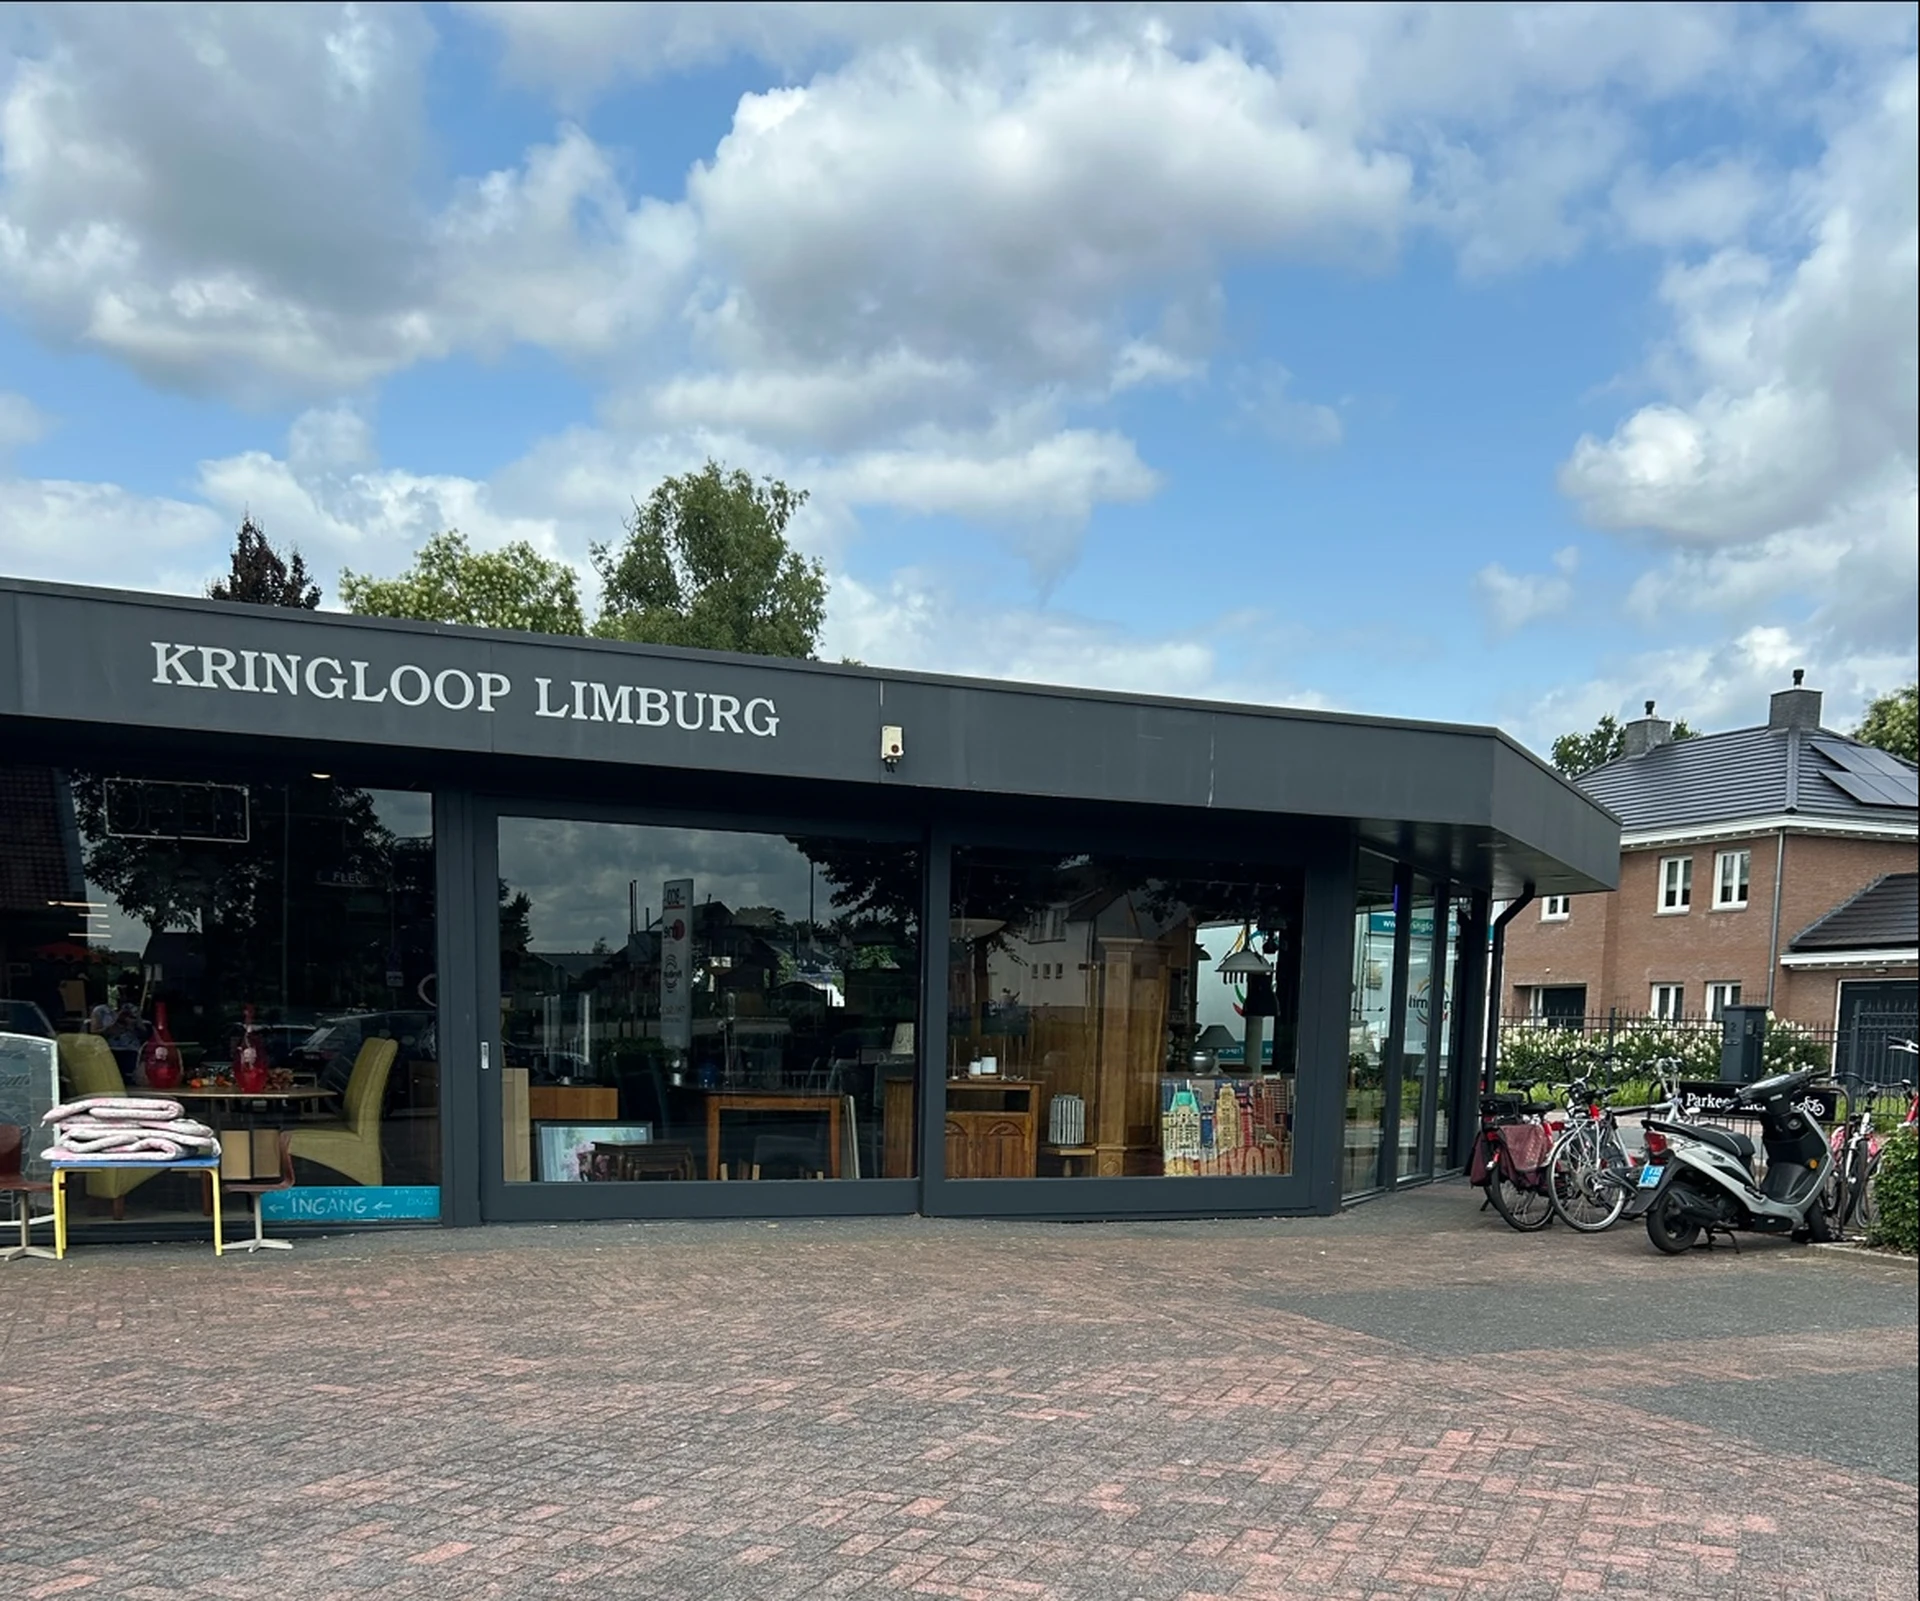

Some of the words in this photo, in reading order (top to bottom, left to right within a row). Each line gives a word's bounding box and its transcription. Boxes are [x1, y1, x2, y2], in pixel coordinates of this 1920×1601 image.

[151, 642, 511, 712] KRINGLOOP
[535, 678, 779, 737] LIMBURG
[291, 1197, 368, 1214] INGANG
